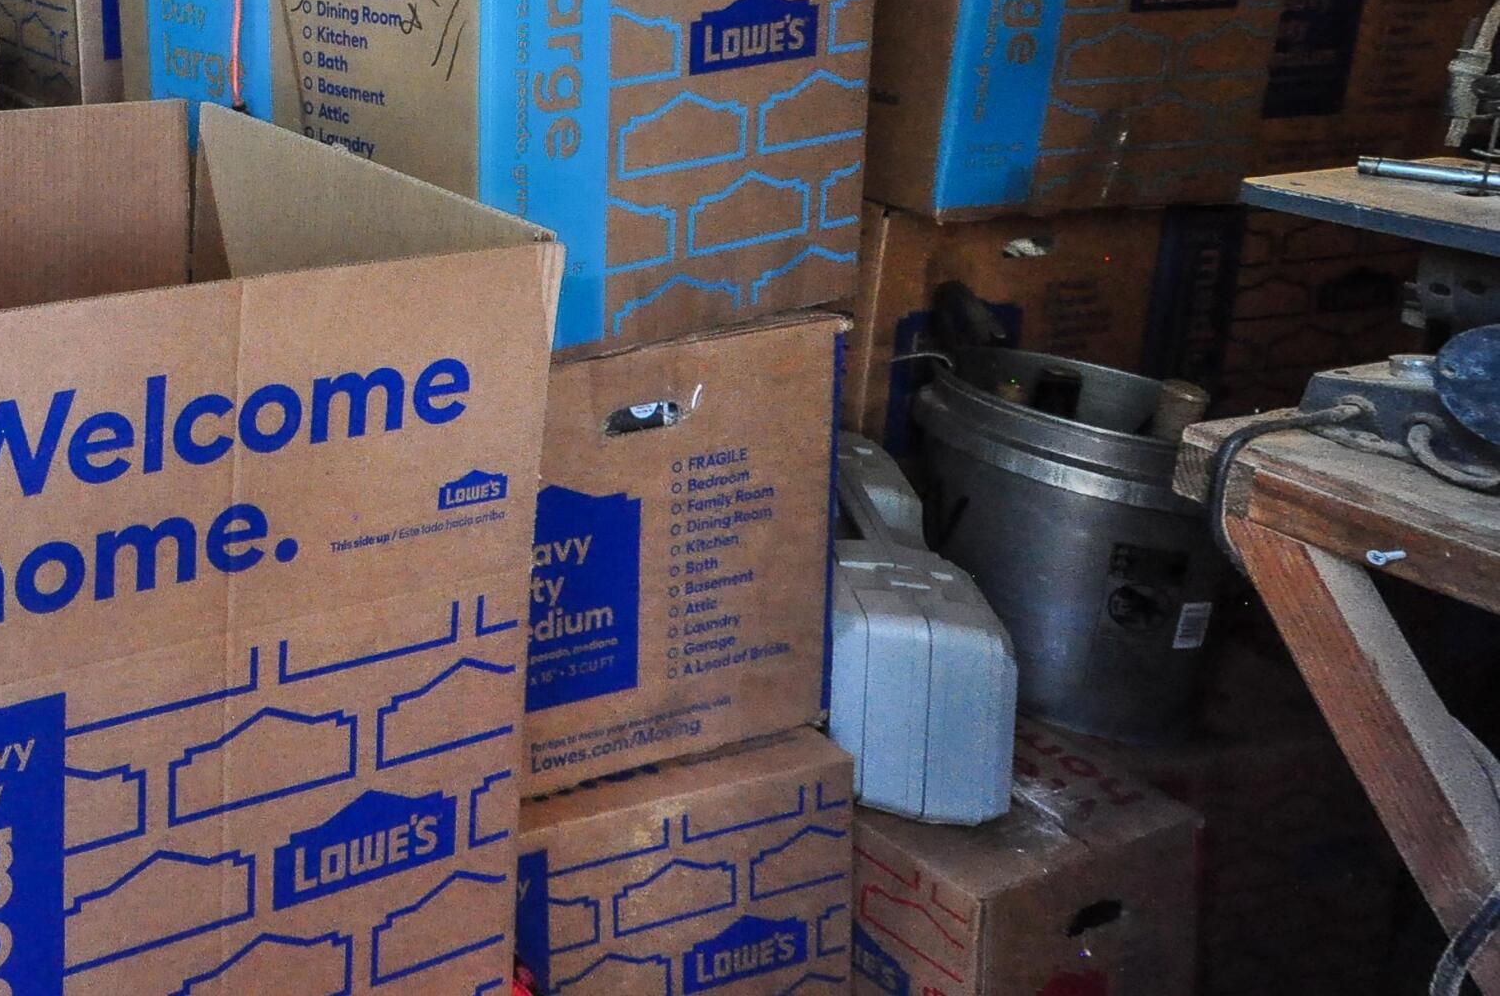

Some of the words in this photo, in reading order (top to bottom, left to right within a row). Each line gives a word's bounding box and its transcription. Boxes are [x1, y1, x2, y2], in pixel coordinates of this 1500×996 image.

[317, 0, 358, 24] Dining
[362, 6, 402, 26] Room
[317, 26, 368, 49] Kitchen
[704, 13, 805, 63] LOWE'S
[318, 52, 348, 72] Bath
[318, 78, 385, 106] Basement
[318, 103, 350, 124] Attic
[688, 448, 748, 471] FRAGILE
[445, 480, 501, 506] LOWE'S
[688, 470, 750, 492] Bedroom
[688, 493, 732, 512] Family
[736, 487, 774, 503] Room
[687, 516, 731, 532] Dining
[734, 508, 772, 524] Room
[532, 534, 592, 565] avy
[686, 535, 739, 554] Kitchen
[531, 576, 565, 606] ty
[685, 570, 754, 595] Basement
[533, 606, 613, 642] dium
[684, 636, 736, 655] Garage
[292, 812, 441, 892] LOWE'S
[696, 933, 796, 983] LOWE'S
